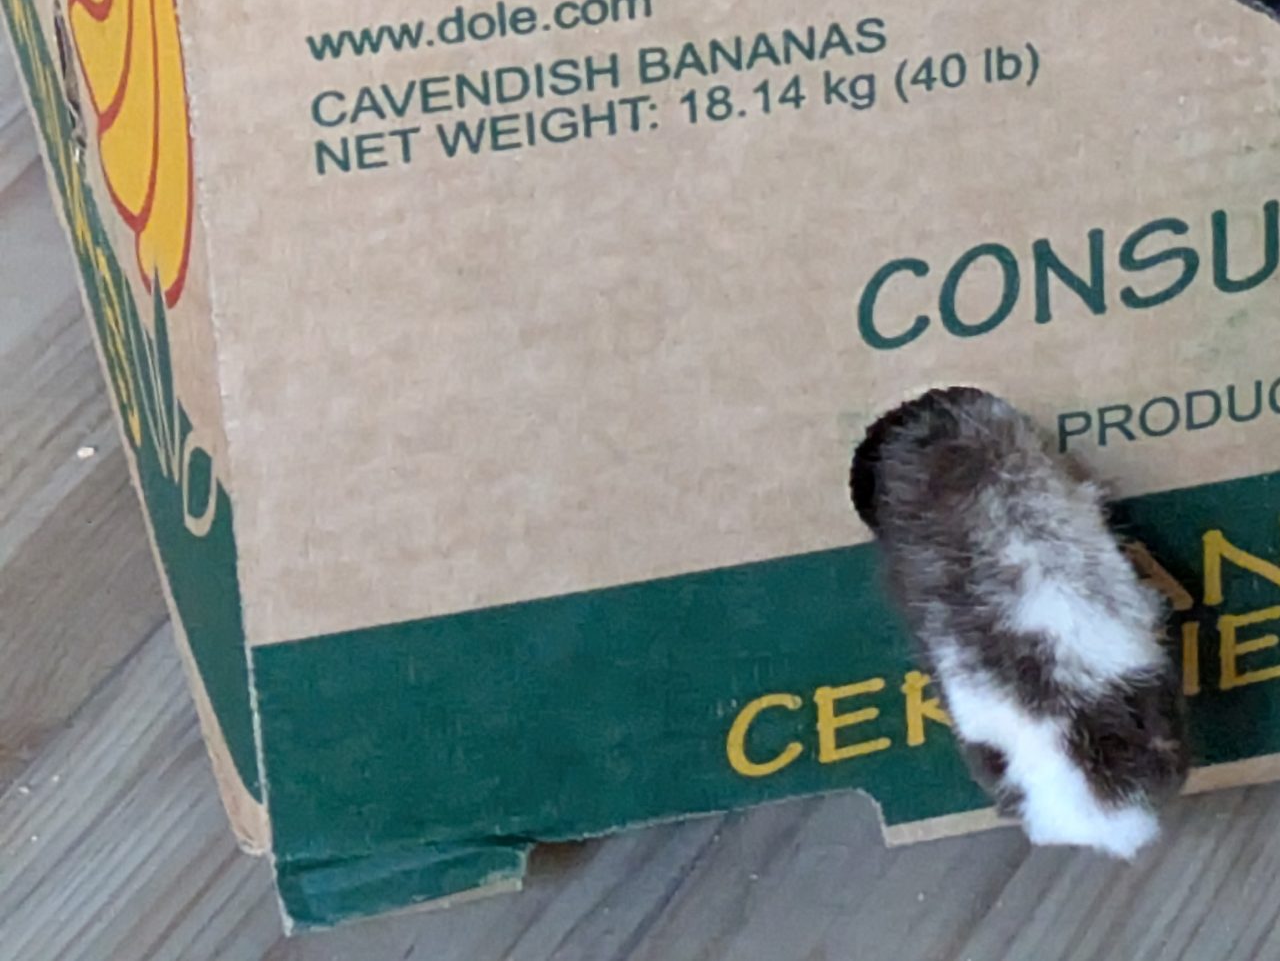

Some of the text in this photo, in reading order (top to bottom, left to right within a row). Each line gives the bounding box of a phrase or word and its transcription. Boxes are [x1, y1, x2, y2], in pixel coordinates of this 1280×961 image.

[310, 16, 888, 128] CAVENDISH BANANAS
[313, 42, 1041, 176] NET WEIGHT: 18.14 kg (40 lb)
